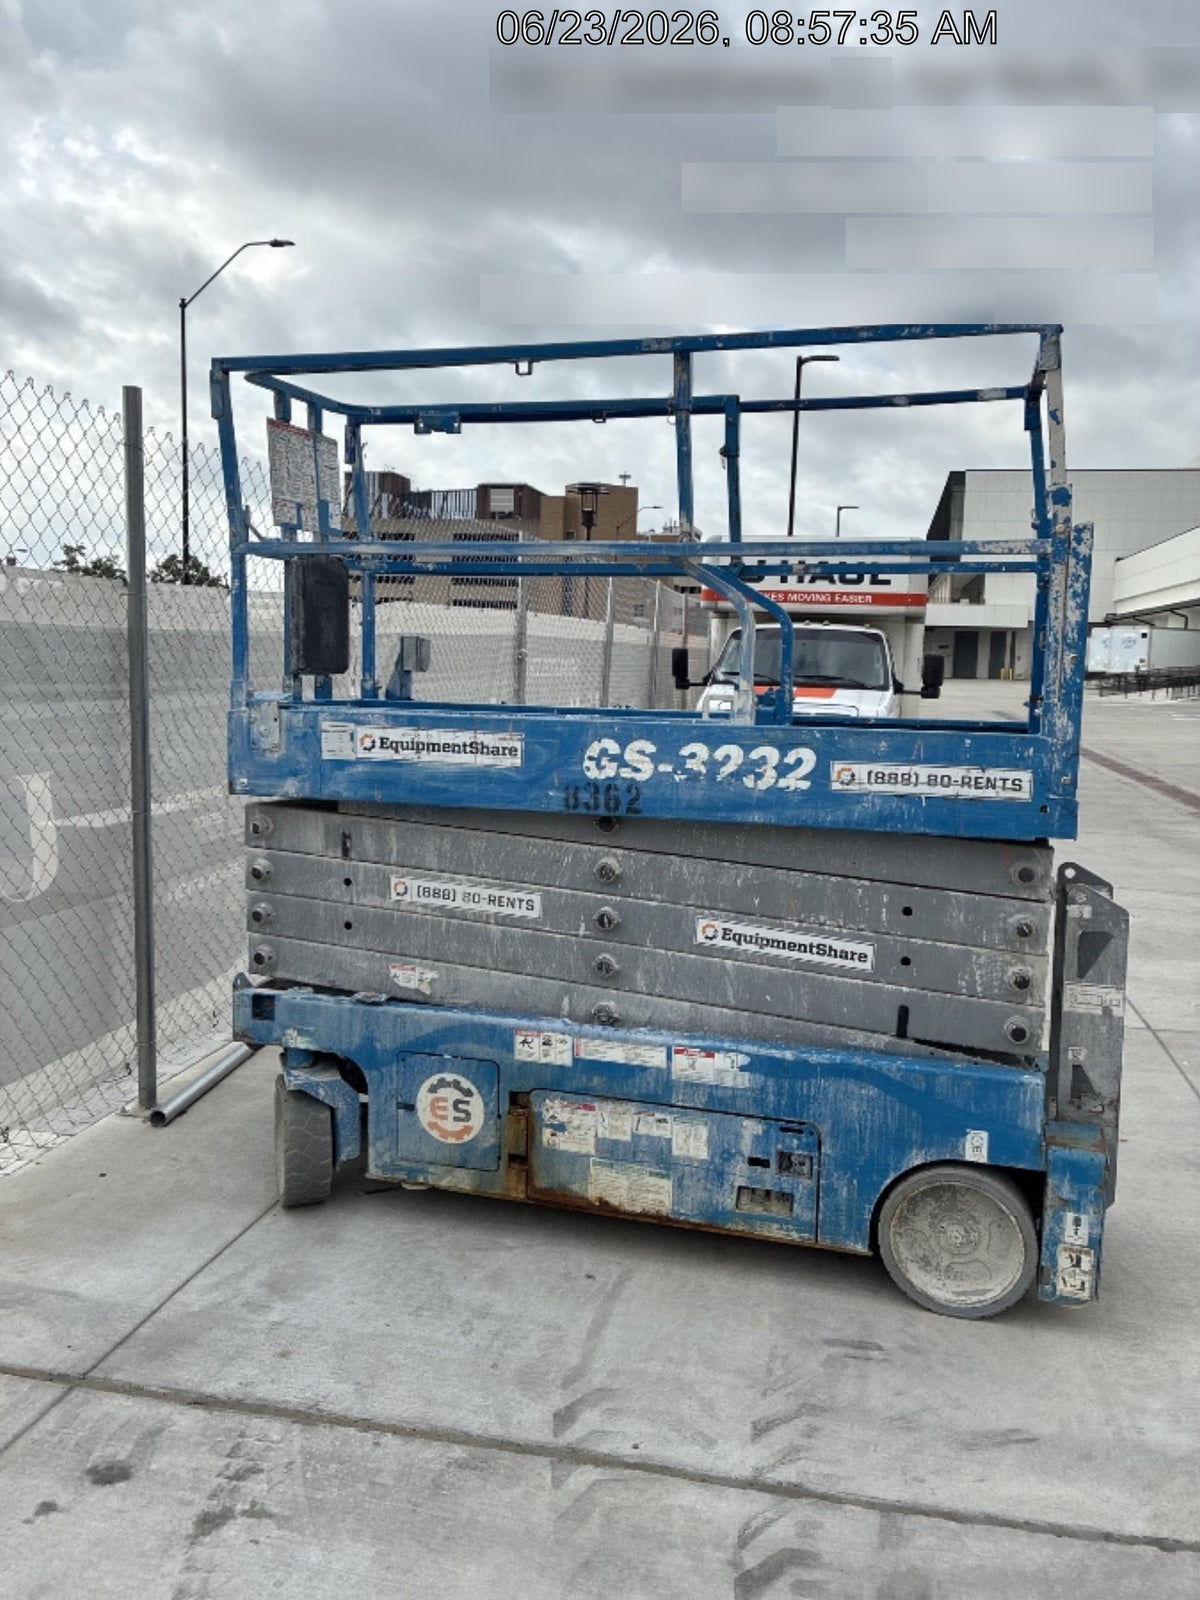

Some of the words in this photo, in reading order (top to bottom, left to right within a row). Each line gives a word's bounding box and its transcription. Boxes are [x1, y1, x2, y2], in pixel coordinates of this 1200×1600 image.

[787, 593, 831, 603] MOVING
[379, 736, 519, 757] EquipmentShare
[583, 738, 817, 791] GS-3232
[927, 774, 1023, 792] 80-RENTS
[462, 891, 535, 911] 80-RENTS
[721, 927, 869, 963] EquipmentShare
[430, 1096, 472, 1122] ES
